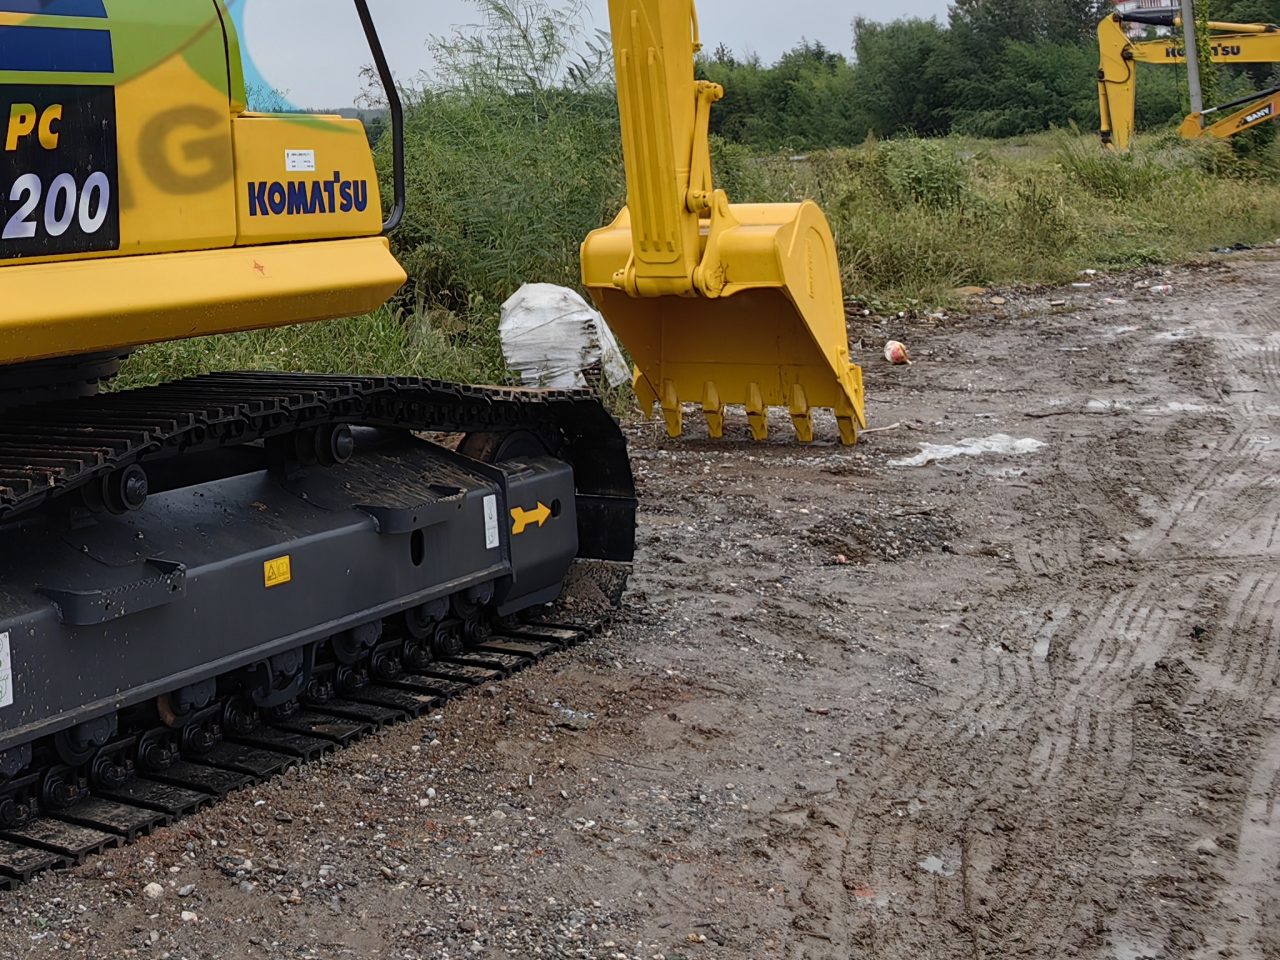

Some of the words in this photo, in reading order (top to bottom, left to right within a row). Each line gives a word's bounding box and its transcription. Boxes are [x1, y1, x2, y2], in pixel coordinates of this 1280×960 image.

[5, 103, 63, 151] PC
[1, 171, 110, 240] 200
[247, 171, 368, 216] KOMATSU
